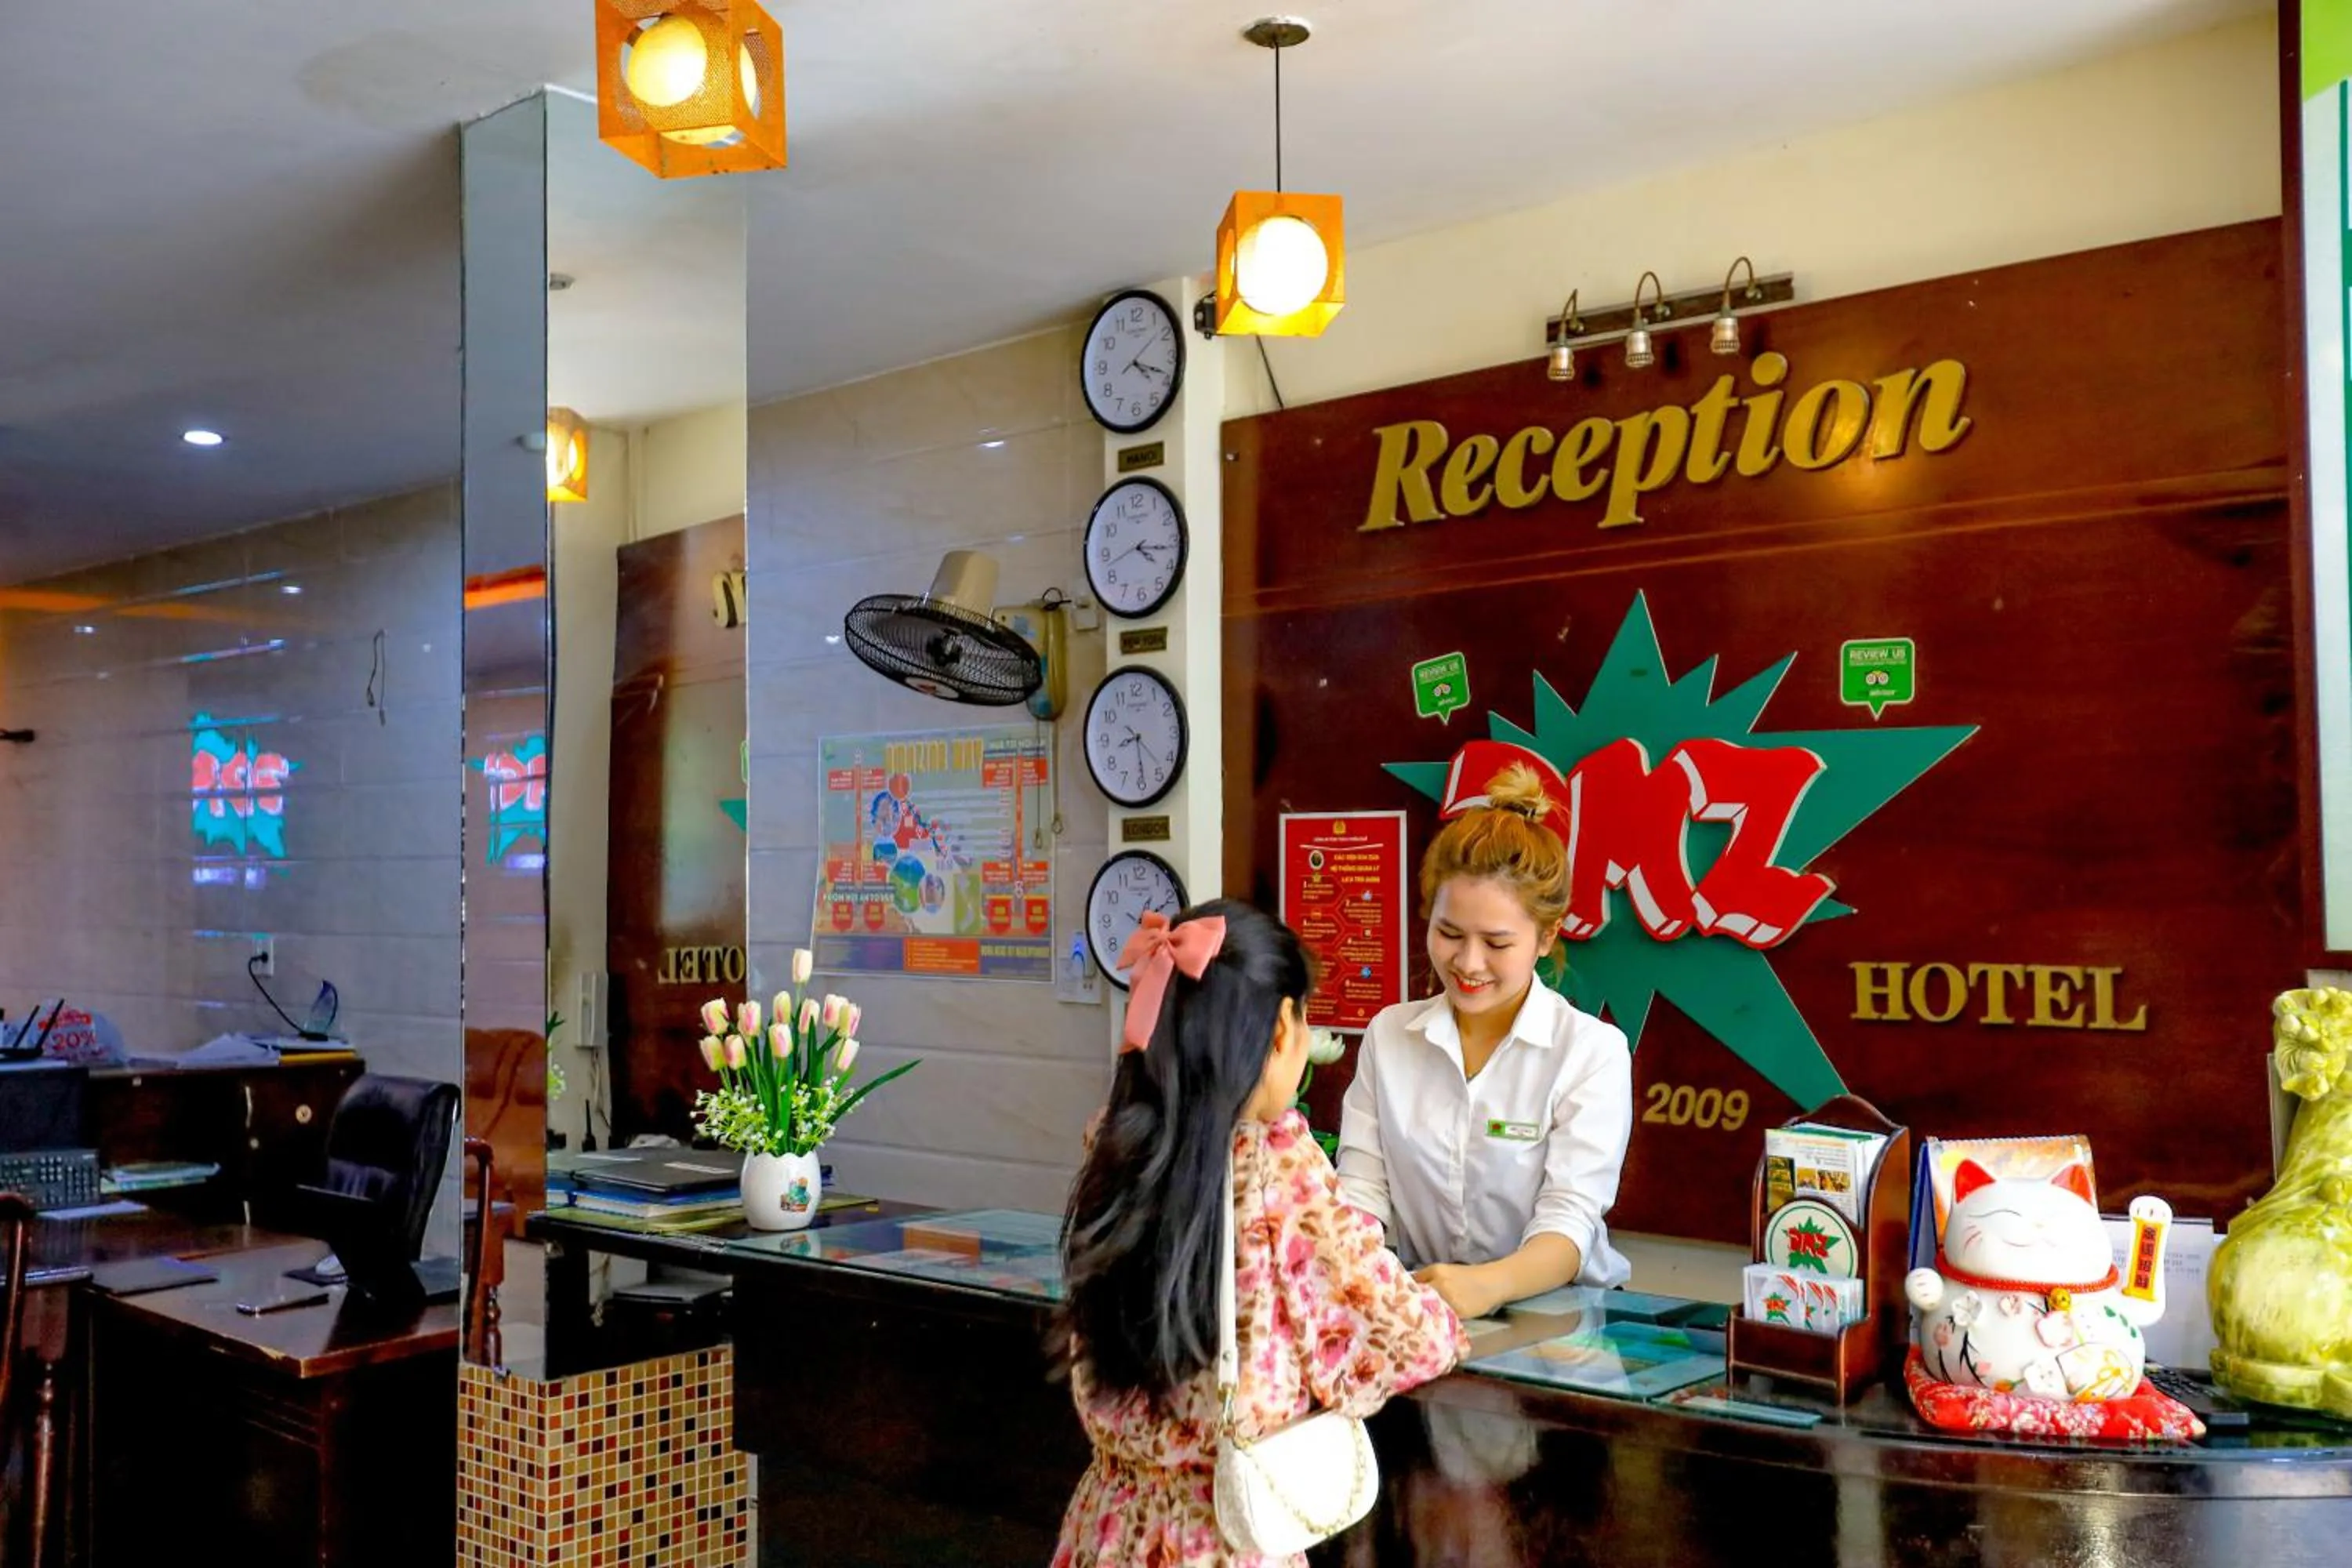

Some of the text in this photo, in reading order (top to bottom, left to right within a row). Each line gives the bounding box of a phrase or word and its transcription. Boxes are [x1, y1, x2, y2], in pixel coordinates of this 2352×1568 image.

[1131, 307, 1143, 322] 12
[1116, 318, 1125, 332] 11
[1161, 326, 1172, 341] 2
[1104, 336, 1115, 350] 10
[1098, 361, 1107, 375] 9
[1104, 383, 1112, 397] 8
[1115, 397, 1124, 411] 7
[1149, 392, 1159, 406] 5
[1131, 401, 1142, 416] 6
[1357, 352, 1972, 531] Reception
[1130, 493, 1143, 508] 12
[1117, 505, 1126, 518] 11
[1163, 510, 1172, 526] 2
[1105, 523, 1117, 538] 10
[1102, 547, 1110, 561] 9
[1166, 559, 1174, 570] 4
[1108, 569, 1117, 584] 8
[1155, 576, 1163, 591] 5
[1120, 583, 1128, 601] 7
[1138, 586, 1147, 601] 6
[1850, 647, 1905, 660] REVIEW US
[1130, 683, 1142, 697] 12
[1116, 691, 1125, 705] 11
[1104, 709, 1116, 724] 10
[1163, 702, 1172, 717] 2
[1169, 726, 1178, 739] 3
[1100, 733, 1109, 748] 9
[1107, 756, 1117, 771] 8
[1166, 751, 1174, 764] 4
[1120, 771, 1128, 790] 7
[1155, 767, 1164, 782] 5
[1119, 873, 1128, 887] 11
[1133, 866, 1146, 880] 12
[1106, 890, 1119, 904] 10
[1165, 889, 1175, 903] 2
[1102, 913, 1111, 928] 9
[1108, 937, 1117, 952] 8
[1849, 961, 2147, 1031] HOTEL
[1642, 1082, 1750, 1131] 2009
